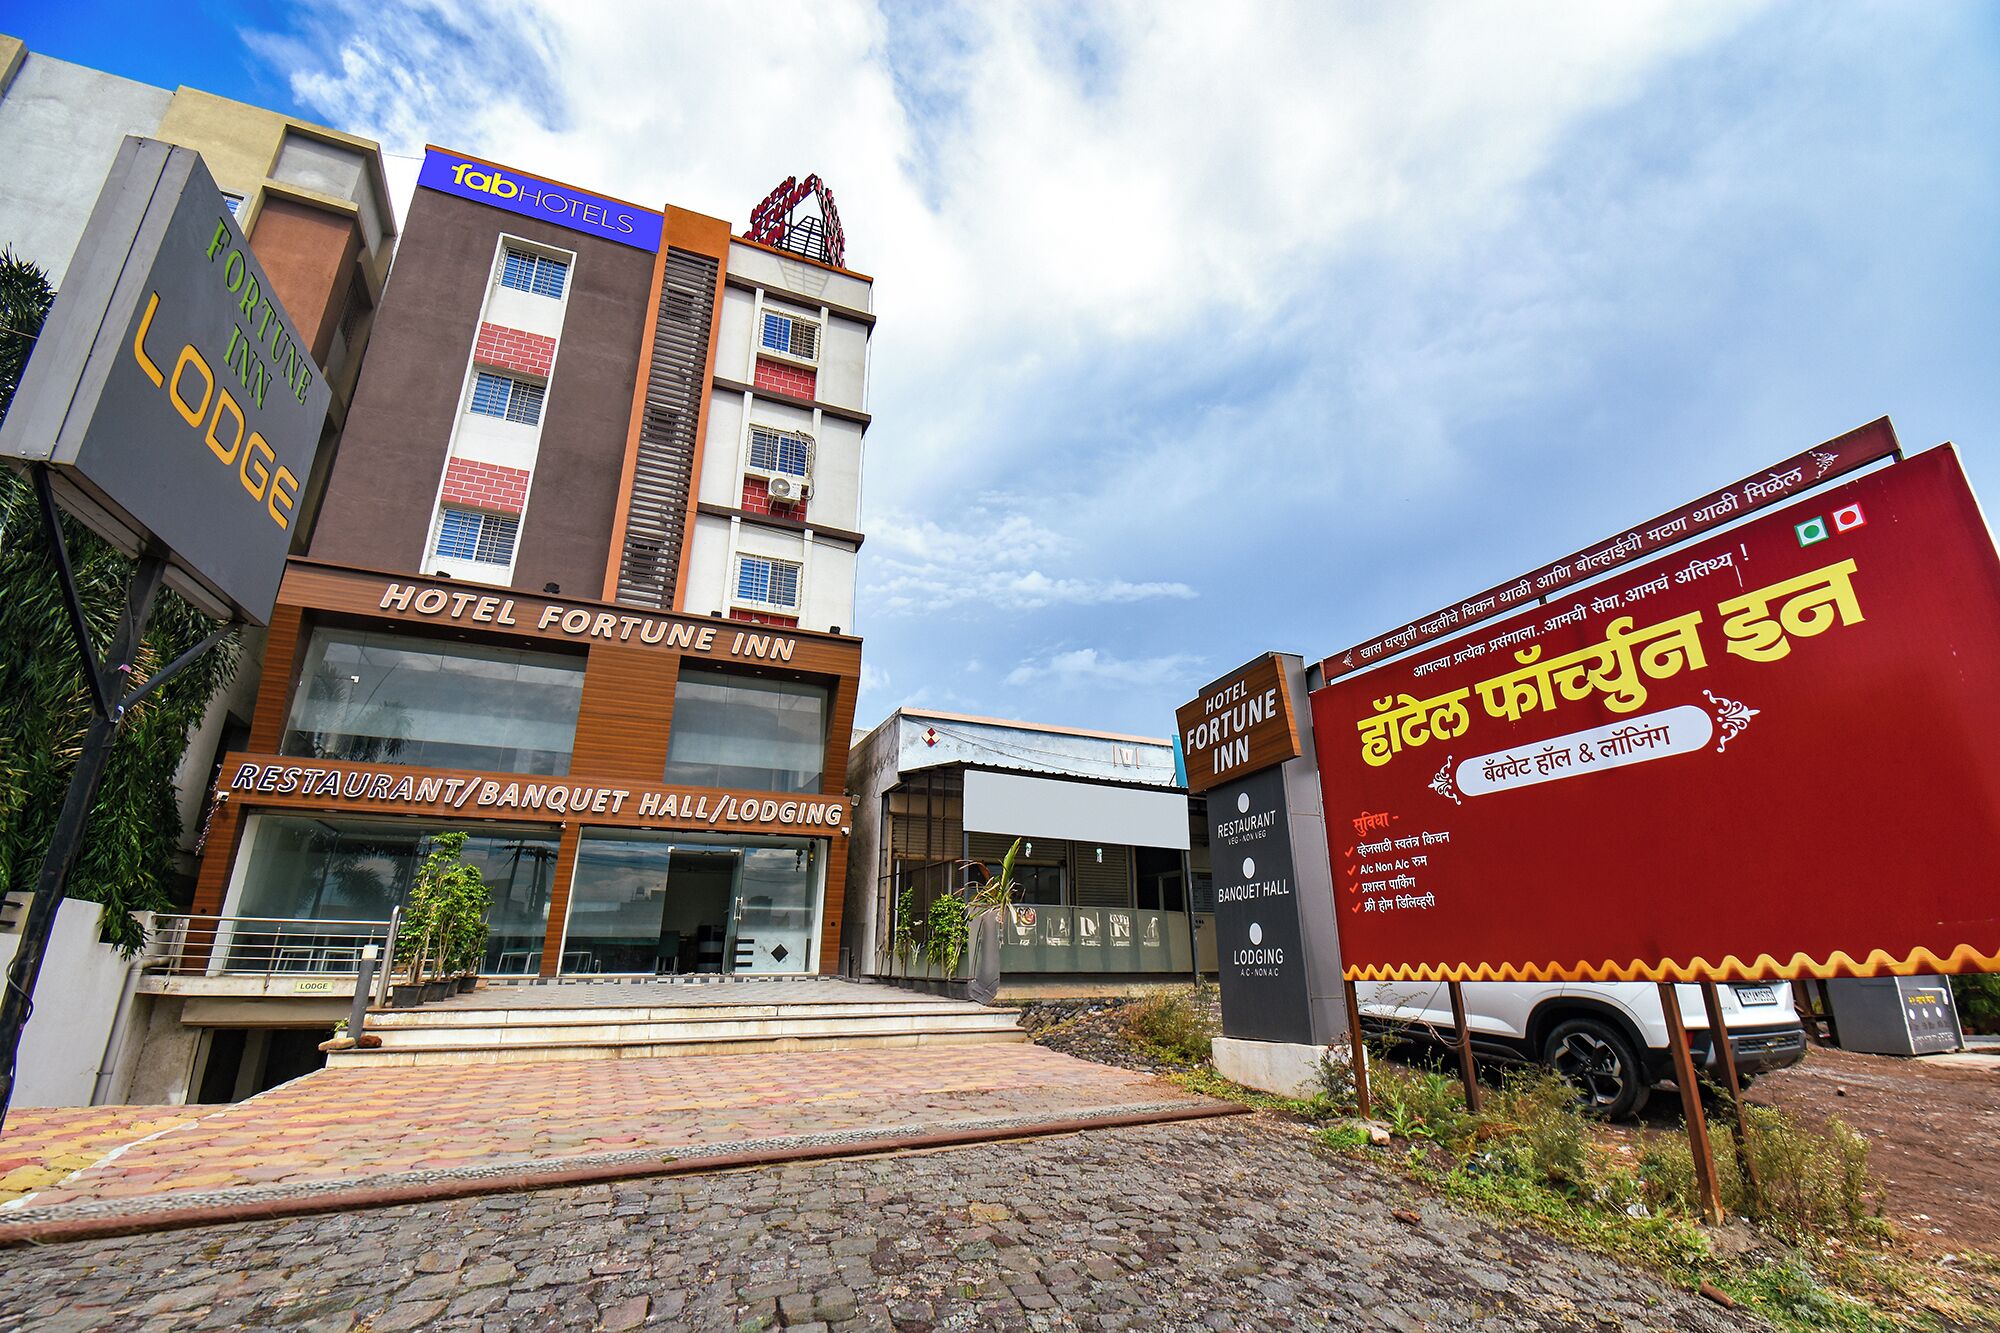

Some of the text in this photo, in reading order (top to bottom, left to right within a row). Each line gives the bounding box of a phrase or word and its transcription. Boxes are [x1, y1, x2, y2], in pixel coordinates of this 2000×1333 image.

[451, 163, 634, 234] fabHOTELS
[206, 216, 313, 406] FORTUNE
[223, 322, 274, 410] INN
[133, 290, 300, 531] LODGE
[1360, 641, 1382, 660] खास
[1385, 625, 1417, 648] घरगुती
[1462, 596, 1495, 621] चिकन
[1499, 579, 1532, 603] थाळी
[1536, 564, 1572, 589] आणि
[1646, 516, 1688, 542] मटण
[1693, 493, 1739, 523] थाळी
[1743, 466, 1802, 504] मिळेल
[380, 583, 796, 662] HOTEL FORTUNE INN
[1413, 653, 1451, 678] आपल्या
[1454, 643, 1486, 665] प्रत्येक
[1675, 552, 1733, 585] अतिथ्य
[1357, 687, 1470, 767] हॉटेल
[1717, 558, 1866, 663] इन
[1205, 680, 1248, 715] HOTEL
[1187, 688, 1276, 756] FORTUNE
[1214, 734, 1249, 775] INN
[1534, 746, 1572, 775] हॉल
[1579, 743, 1595, 763] &
[1597, 724, 1670, 758] लॉजिंग
[1217, 810, 1276, 839] RESTAURANT
[1353, 811, 1390, 837] सुविधा
[1422, 831, 1450, 846] किचन
[1361, 880, 1387, 894] प्रशस्त
[1375, 862, 1393, 872] Non
[1218, 882, 1261, 903] BANQUET
[1263, 879, 1290, 896] HALL
[1364, 898, 1376, 913] फ्री
[1378, 896, 1394, 913] होम
[1234, 948, 1284, 965] LODGING
[300, 982, 328, 990] LODGE
